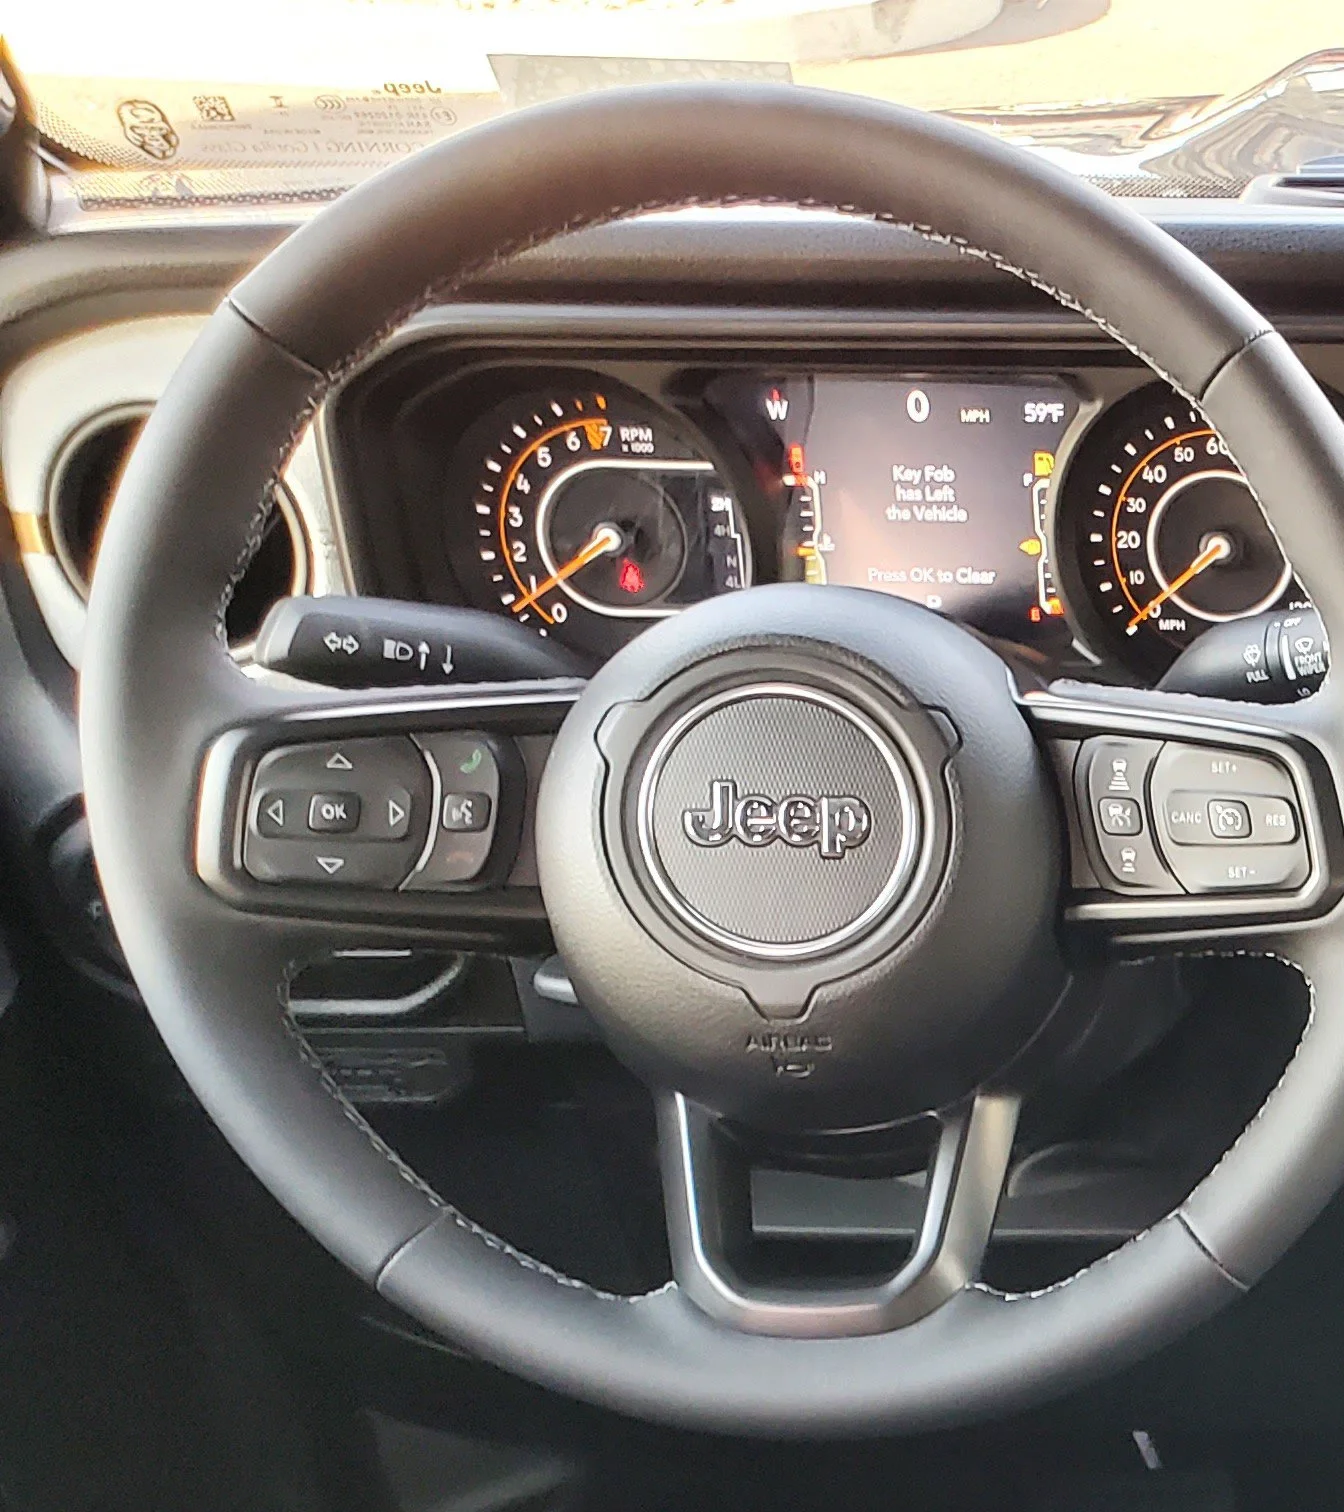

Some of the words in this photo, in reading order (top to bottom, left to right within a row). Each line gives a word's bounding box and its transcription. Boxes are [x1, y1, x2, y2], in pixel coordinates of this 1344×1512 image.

[765, 398, 789, 420] W
[907, 390, 930, 422] 0
[960, 408, 990, 423] MPH
[566, 434, 581, 452] 6
[600, 426, 613, 447] 7
[619, 427, 653, 441] RPM
[537, 447, 551, 469] 5
[1174, 447, 1194, 463] 50
[516, 473, 530, 494] 4
[892, 464, 922, 485] Key
[924, 464, 956, 483] Fob
[1143, 465, 1166, 484] 40
[895, 484, 923, 502] has
[924, 484, 956, 503] Left
[886, 504, 912, 521] the
[913, 504, 968, 523] Vehicle
[1126, 498, 1146, 513] 30
[508, 505, 523, 527] 3
[1117, 531, 1140, 549] 20
[512, 541, 527, 563] 2
[726, 554, 737, 568] N
[867, 567, 907, 583] Press
[910, 567, 935, 583] OK
[937, 569, 954, 583] to
[956, 567, 996, 585] Clear
[1129, 569, 1145, 585] 10
[551, 603, 568, 623] 0
[1159, 619, 1186, 632] MPH
[321, 803, 347, 820] OK
[683, 778, 872, 860] Jeep
[1171, 811, 1202, 824] CANC
[1265, 813, 1287, 827] RES
